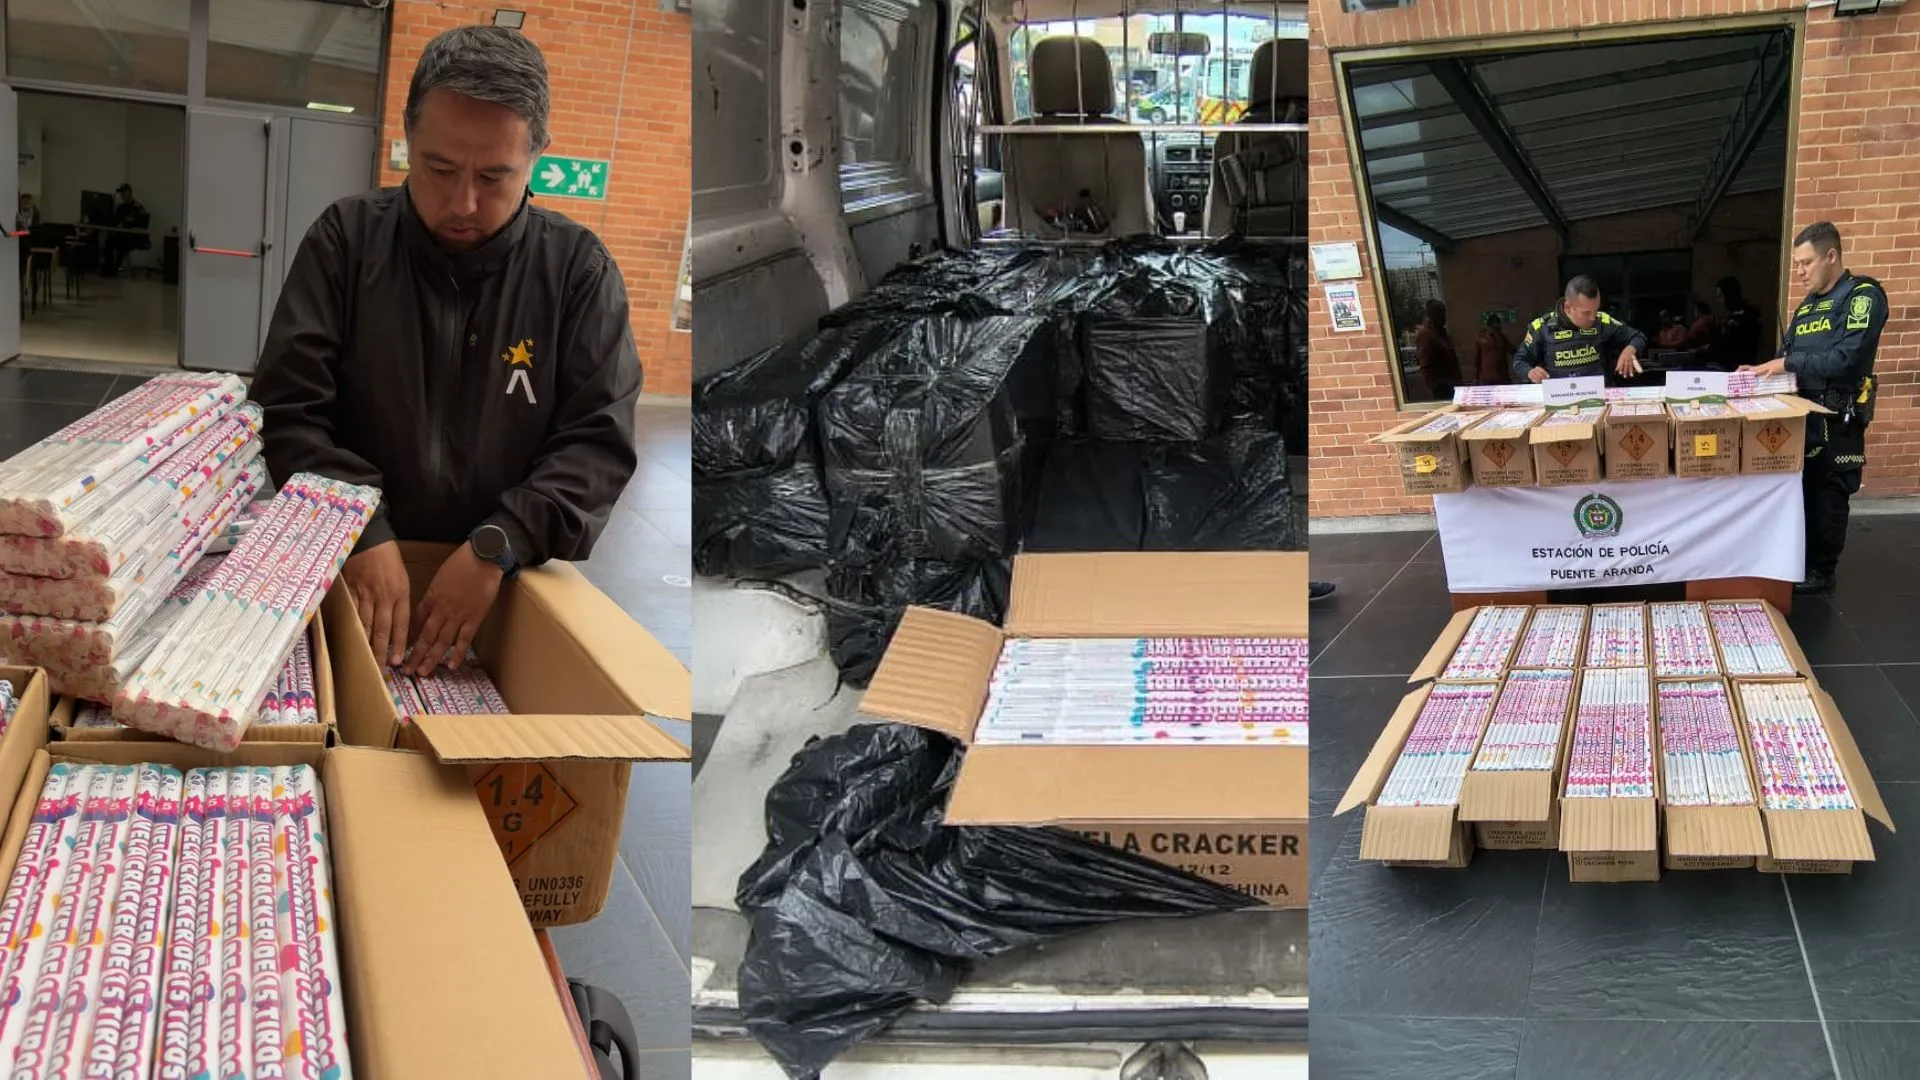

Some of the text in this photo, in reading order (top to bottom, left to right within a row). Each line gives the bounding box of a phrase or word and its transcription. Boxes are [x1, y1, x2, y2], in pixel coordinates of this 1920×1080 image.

[1555, 345, 1597, 361] POLICÍA
[1532, 541, 1670, 558] ESTACIÓN DE POLICÍA
[1550, 563, 1655, 580] PUENTE ARANDA
[489, 774, 544, 807] 1.4
[502, 812, 522, 832] G
[505, 841, 513, 855] 1
[1074, 830, 1300, 856] ELA CRACKER
[528, 876, 584, 891] UN0336
[523, 892, 581, 907] EFULLY
[87, 821, 151, 1079] VELA CRACKER DE 15 TIROS
[162, 826, 201, 1080] VELA CRACKER DE 15 TIROS
[252, 825, 282, 1078] VELA CRACKER DE 15 TIROS
